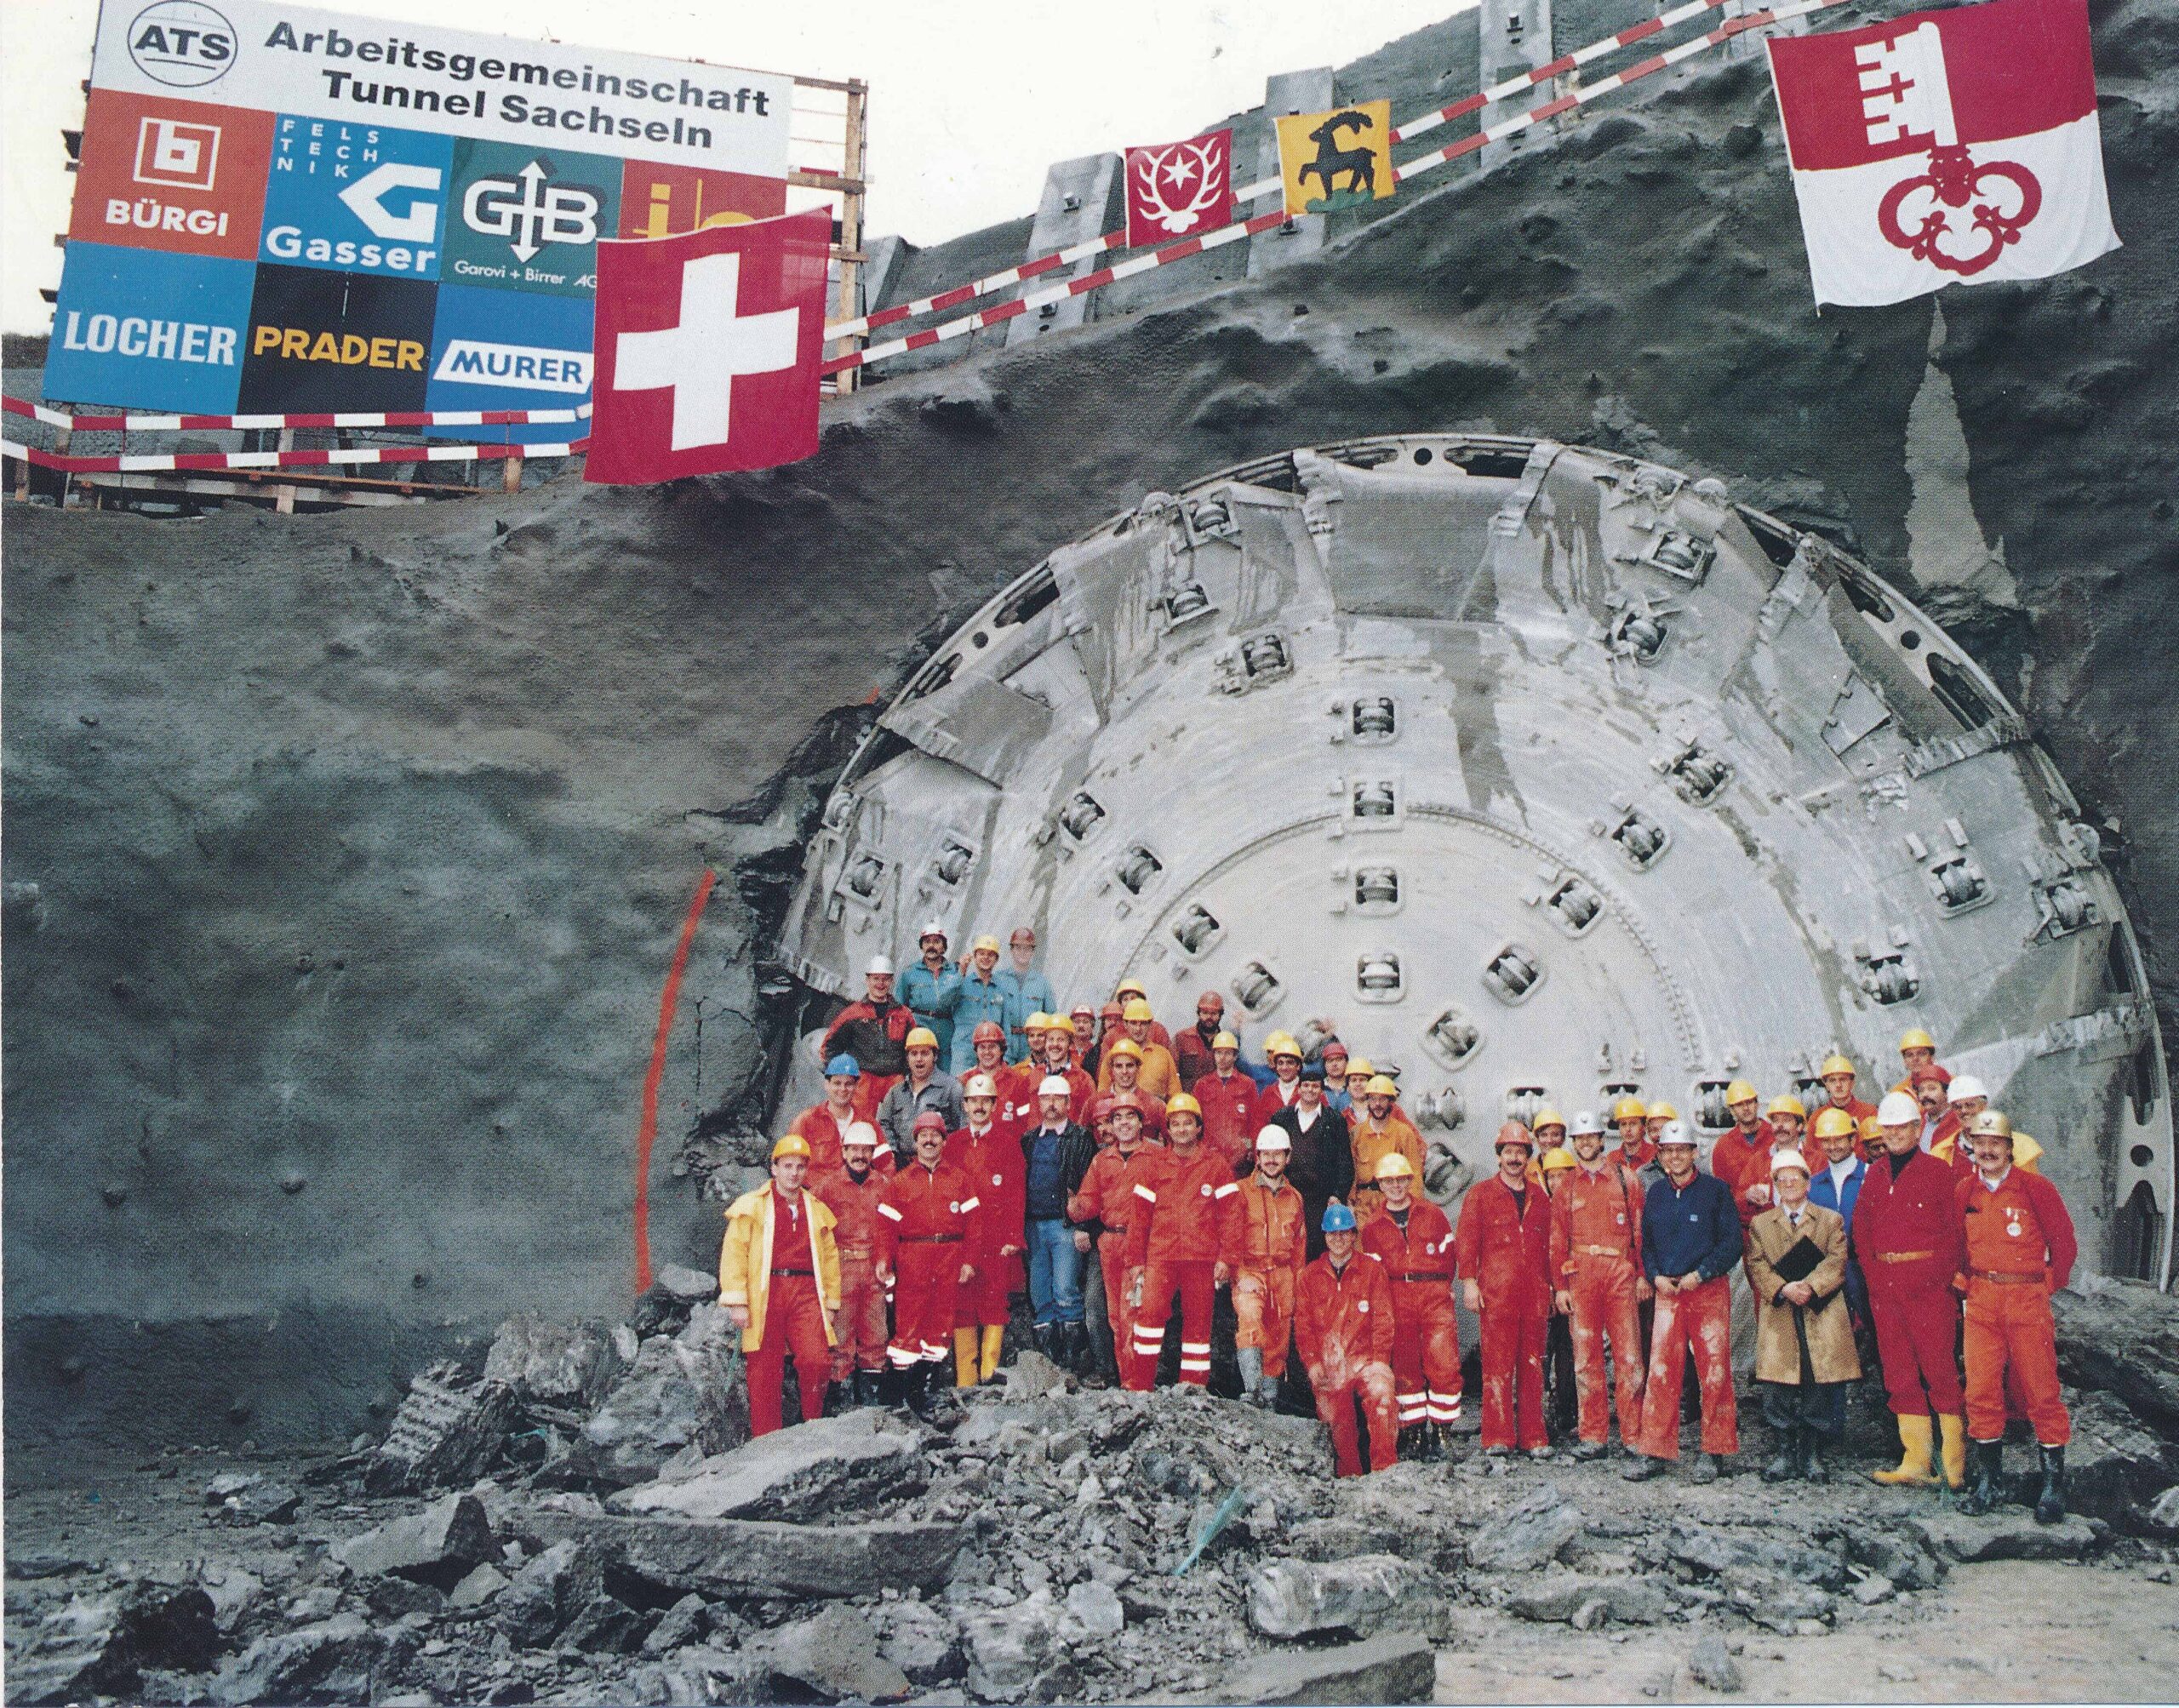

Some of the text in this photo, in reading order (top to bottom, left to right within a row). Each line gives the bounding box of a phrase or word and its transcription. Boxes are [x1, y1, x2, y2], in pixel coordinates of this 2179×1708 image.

[135, 24, 231, 61] ATS
[265, 21, 769, 117] Arbeitsgemeinschaft
[322, 70, 712, 149] Tunnel Sachseln
[105, 198, 228, 237] BÜRGI
[266, 226, 437, 272] Gasser
[455, 260, 506, 278] Garovi
[524, 267, 566, 284] Birrer
[63, 311, 237, 366] LOCHER
[254, 325, 424, 371] PRADER
[450, 350, 584, 385] MURER
